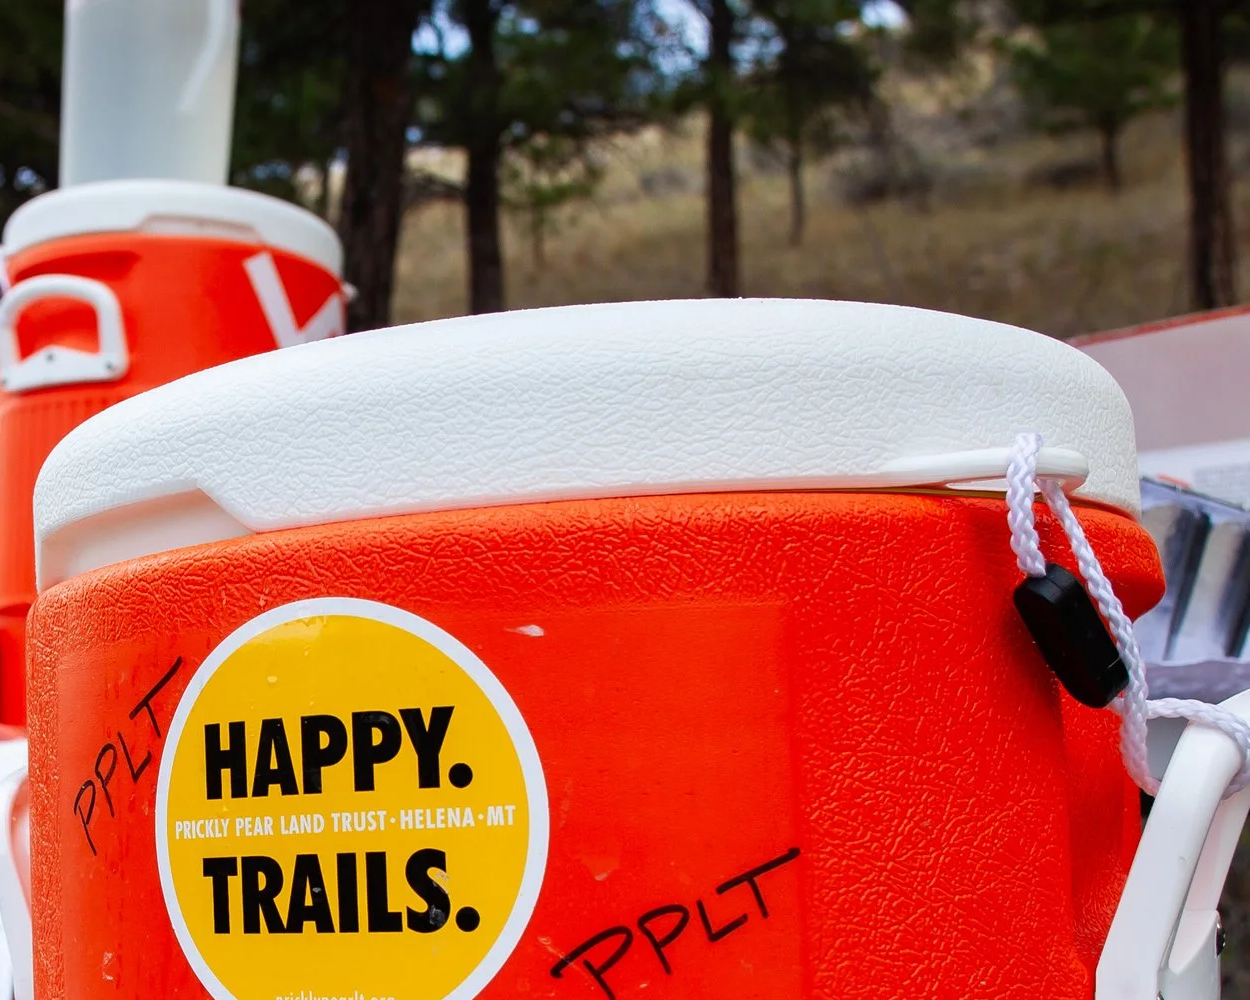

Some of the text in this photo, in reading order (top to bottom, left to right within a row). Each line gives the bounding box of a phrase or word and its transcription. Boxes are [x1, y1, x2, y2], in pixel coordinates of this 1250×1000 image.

[74, 655, 183, 856] PPLT
[204, 706, 473, 800] HAPPY.
[175, 818, 229, 839] PRICKLY
[235, 815, 274, 837] PEAR
[280, 813, 325, 835] LAND
[202, 848, 481, 934] TRAILS.
